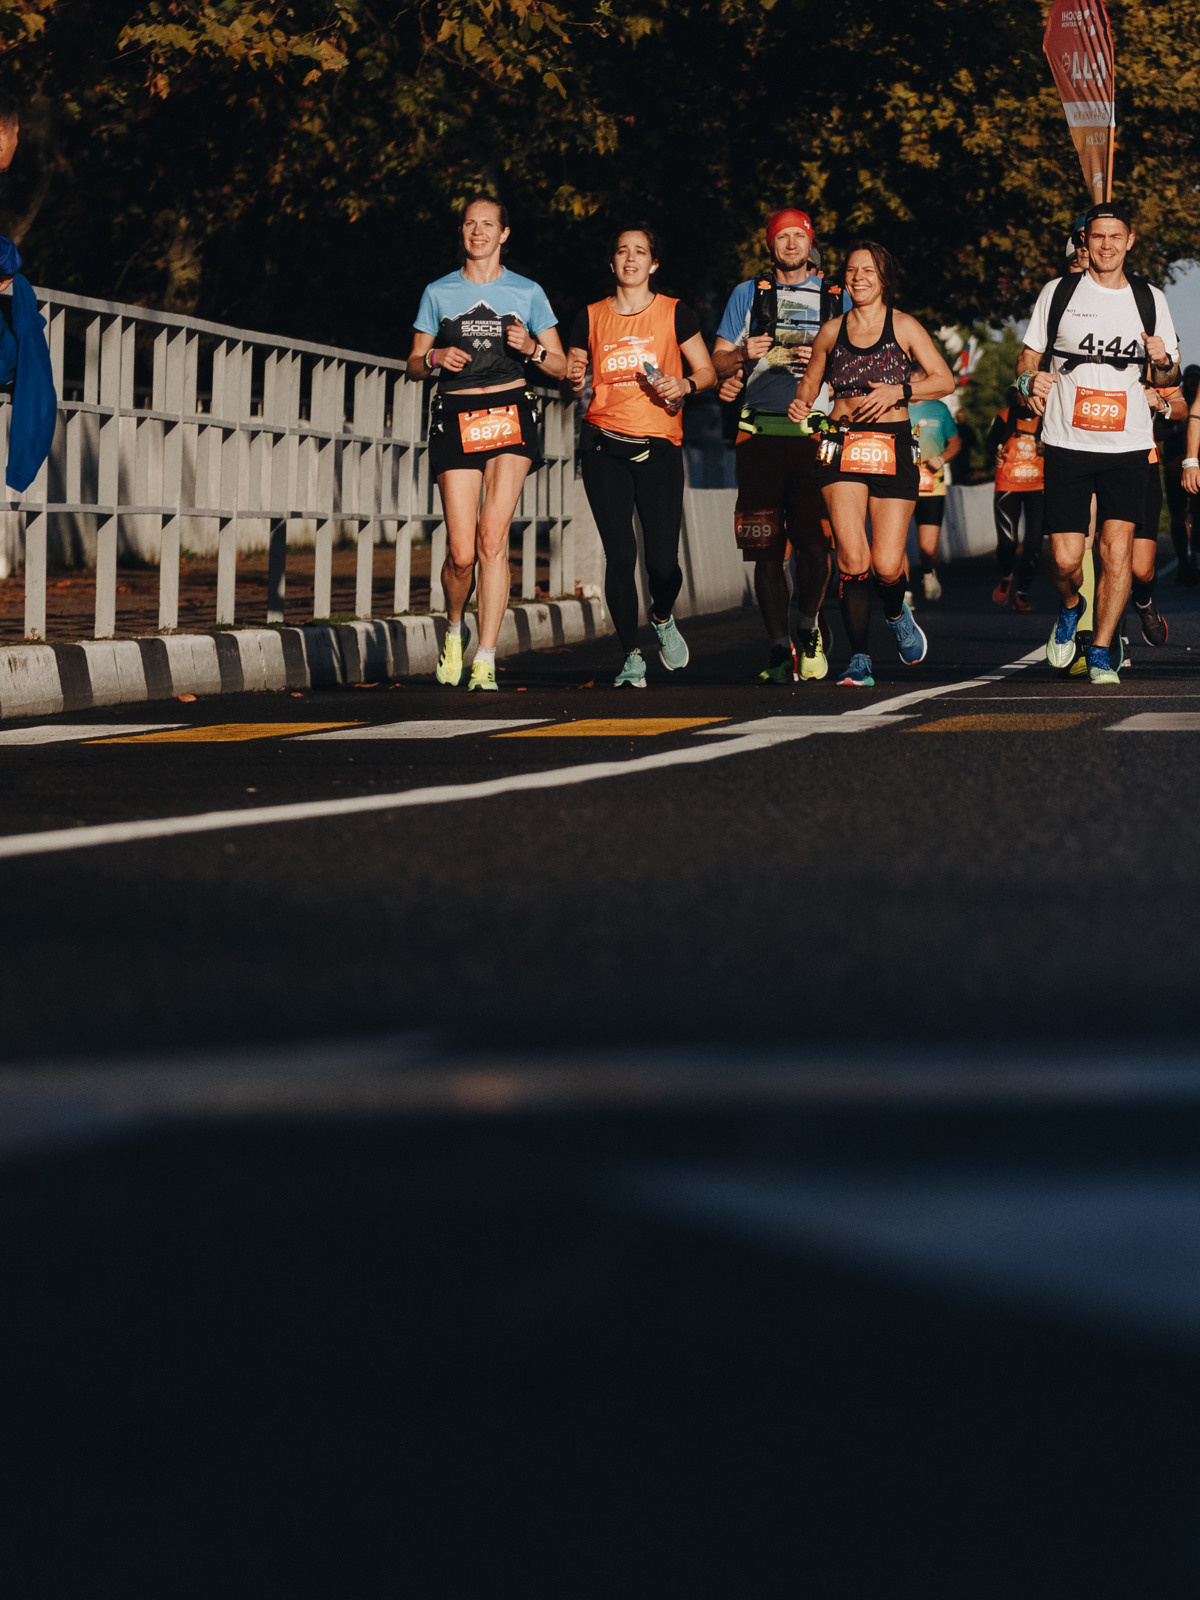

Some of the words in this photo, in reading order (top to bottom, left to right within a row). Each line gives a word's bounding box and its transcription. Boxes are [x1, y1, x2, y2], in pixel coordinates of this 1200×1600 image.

[461, 325, 503, 333] SOCHI
[1078, 332, 1137, 358] 4:44
[607, 353, 648, 371] 8998
[1081, 401, 1119, 418] 8379
[470, 422, 512, 441] 8872
[850, 446, 888, 463] 8501
[737, 524, 772, 538] 8789
